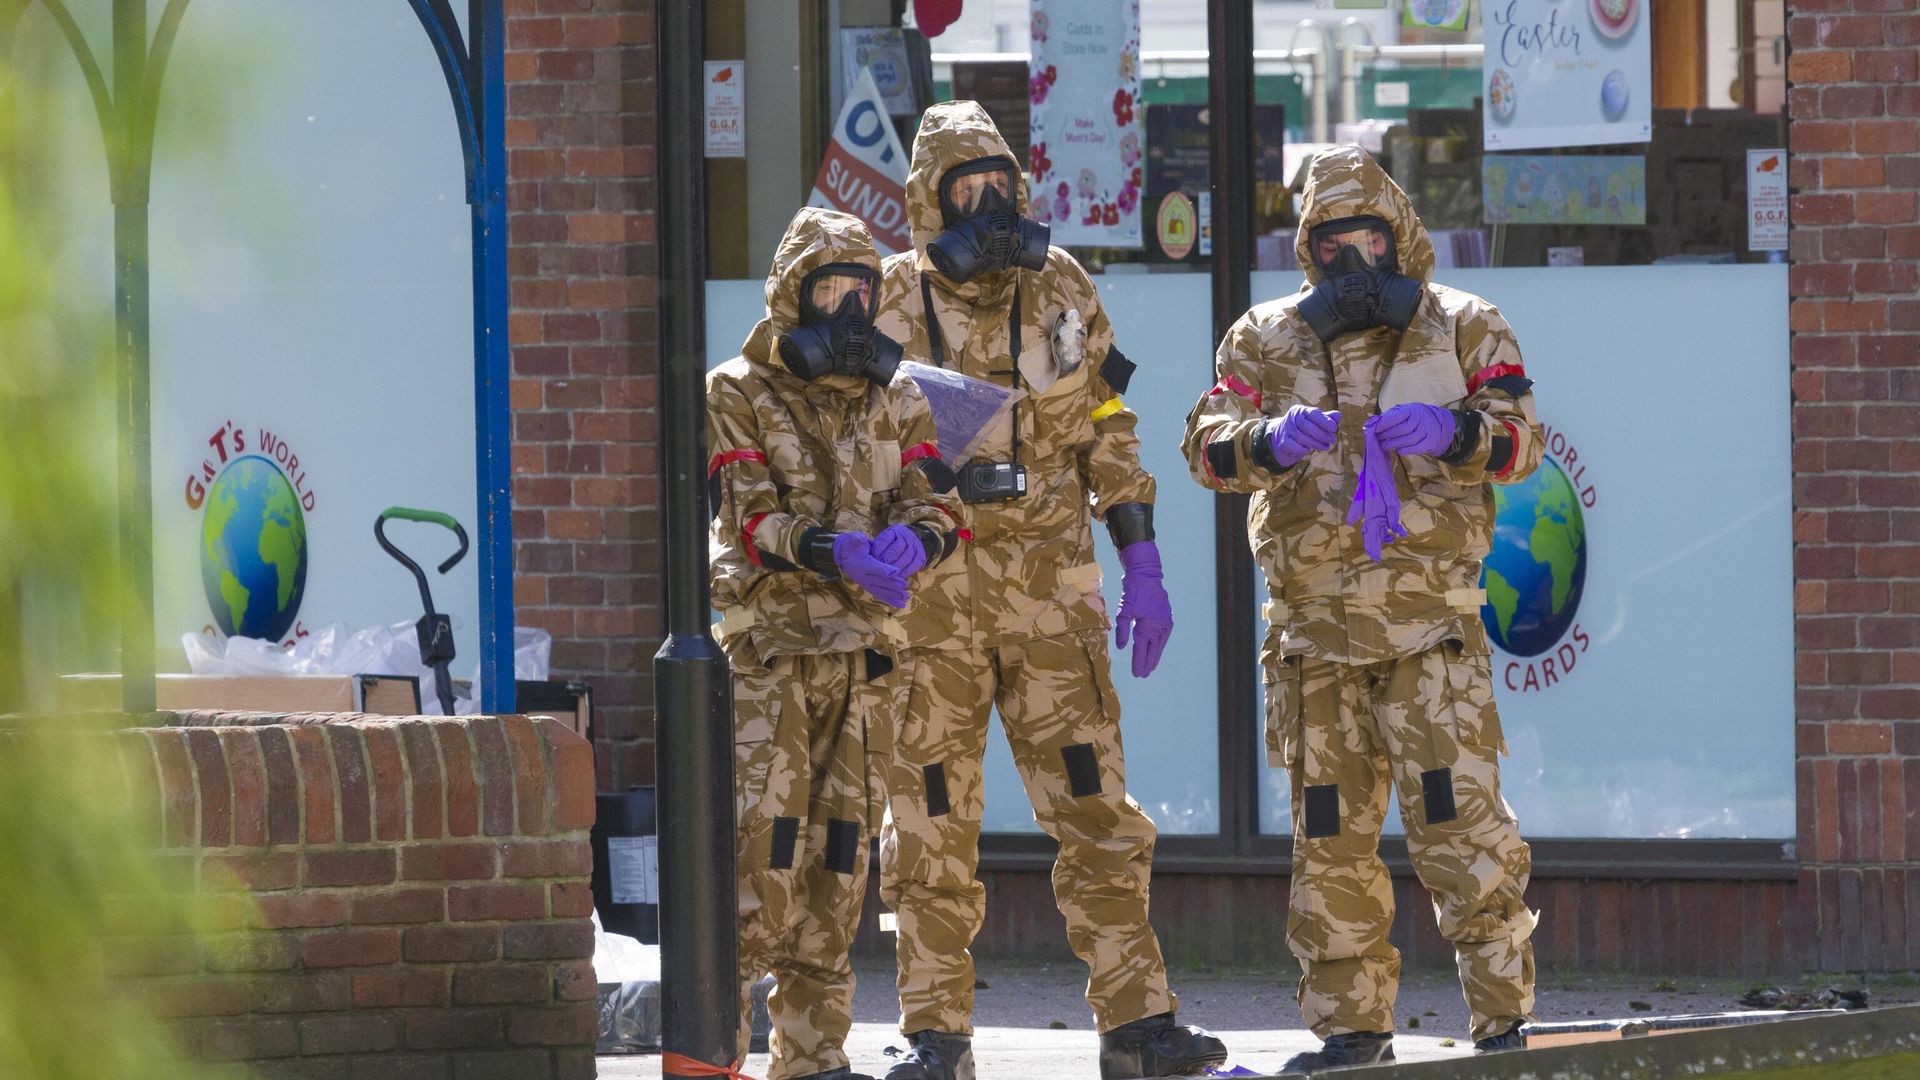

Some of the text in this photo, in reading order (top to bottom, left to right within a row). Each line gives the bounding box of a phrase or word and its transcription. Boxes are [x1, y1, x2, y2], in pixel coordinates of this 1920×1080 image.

[1088, 42, 1108, 55] Now
[1494, 0, 1581, 67] Easter
[1755, 210, 1787, 221] G.G.F.
[260, 428, 315, 511] WORLD
[1505, 624, 1589, 692] CARDS
